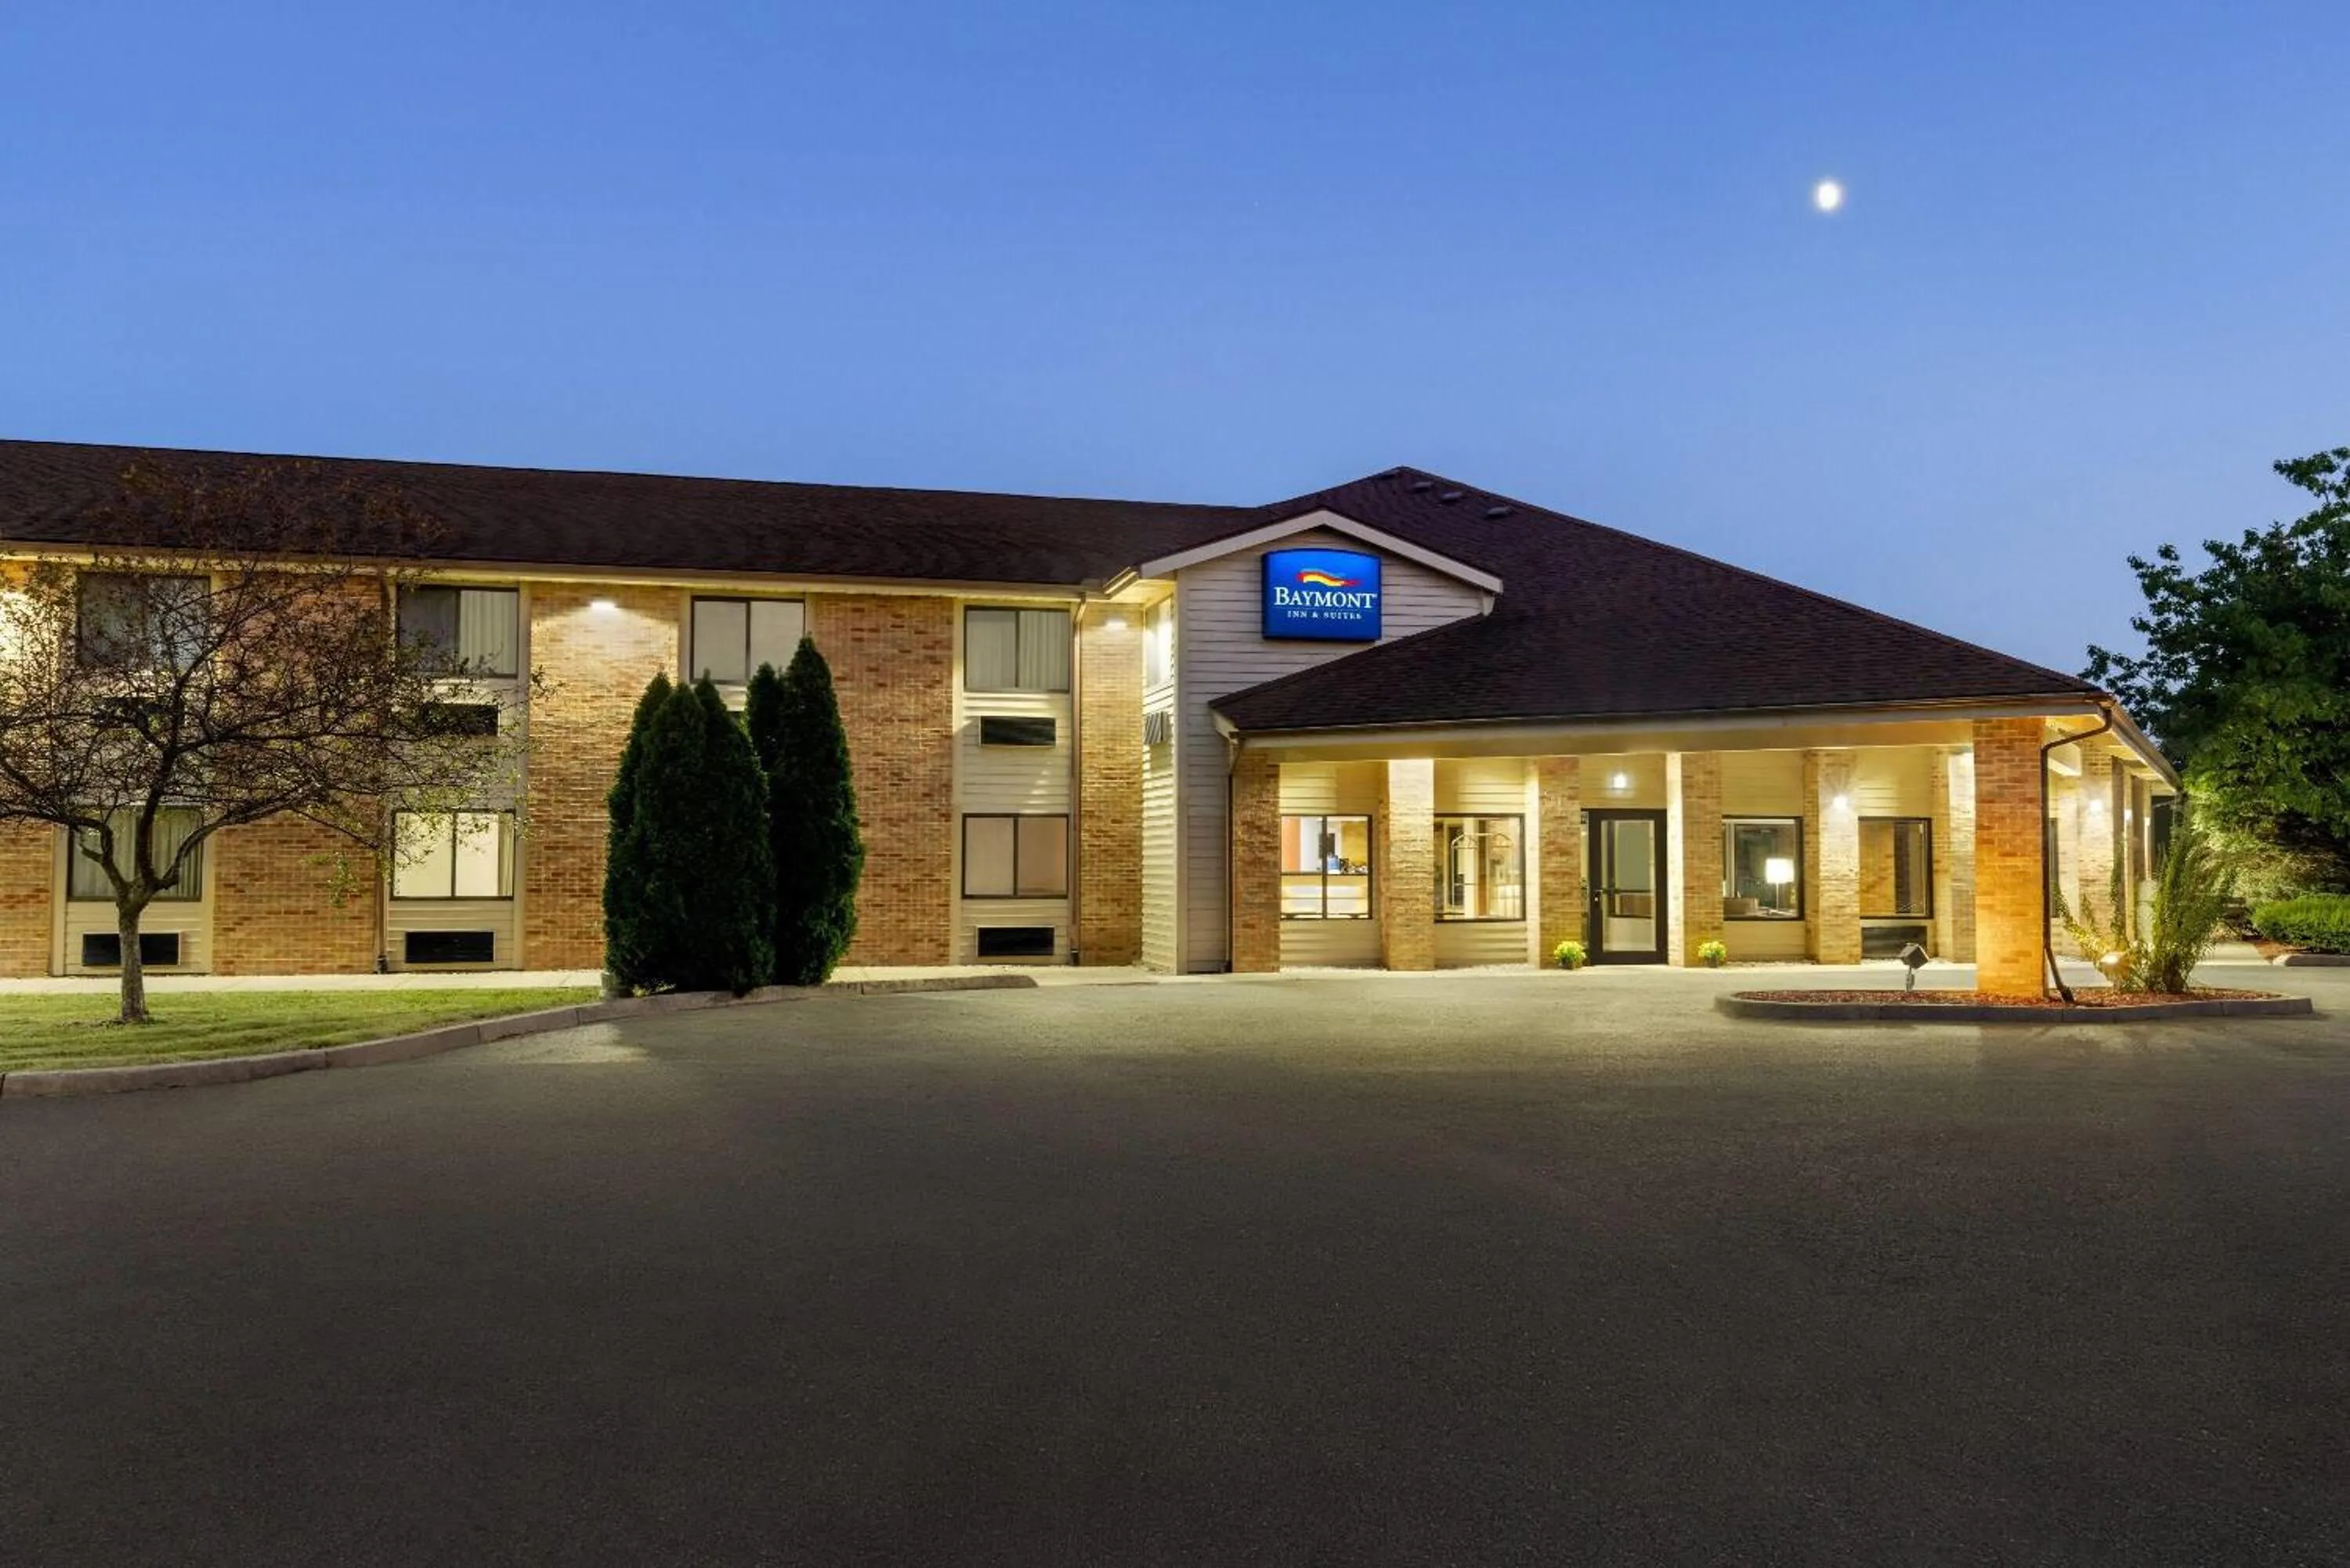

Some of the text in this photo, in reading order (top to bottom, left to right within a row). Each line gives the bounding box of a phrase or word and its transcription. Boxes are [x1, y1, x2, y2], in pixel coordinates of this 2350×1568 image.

[1274, 587, 1376, 609] BAYMONT
[1287, 610, 1362, 620] INN & SUITES
